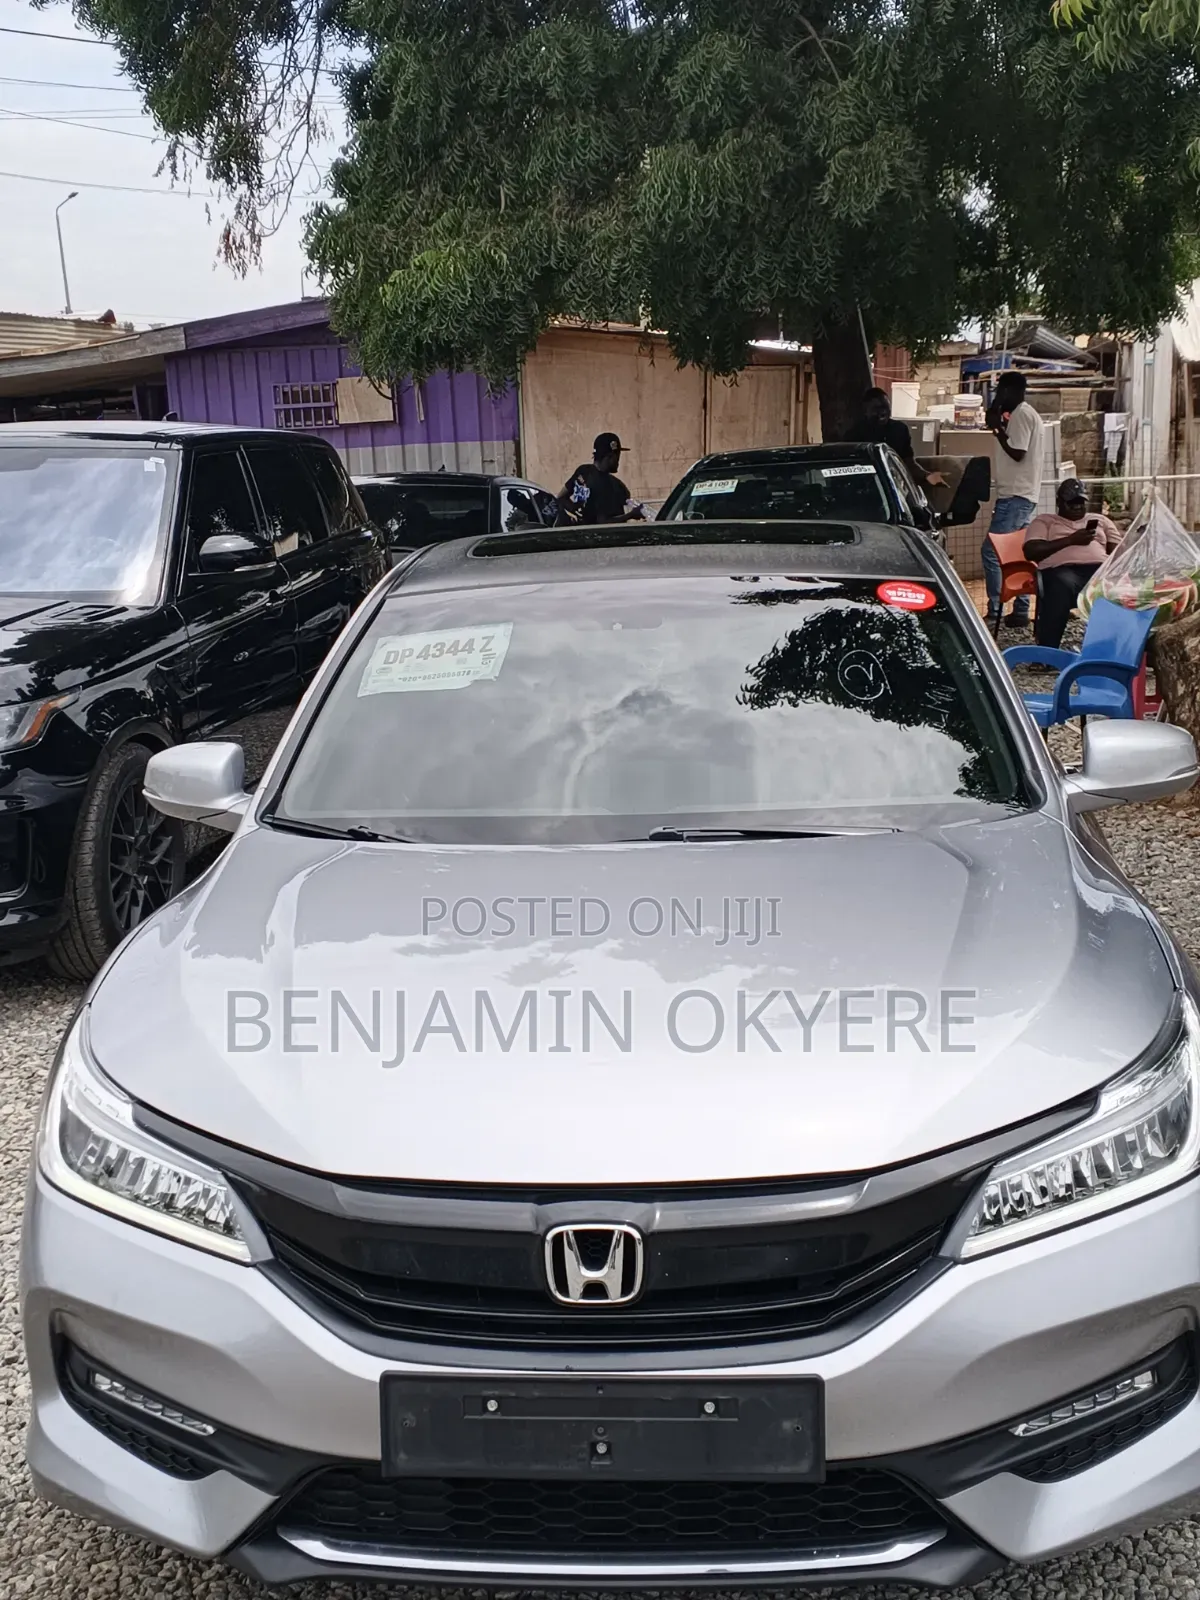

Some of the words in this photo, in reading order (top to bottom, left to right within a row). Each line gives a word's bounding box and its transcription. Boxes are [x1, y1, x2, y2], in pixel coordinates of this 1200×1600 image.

[383, 647, 414, 665] DP
[416, 638, 475, 661] 4344
[479, 635, 495, 653] Z
